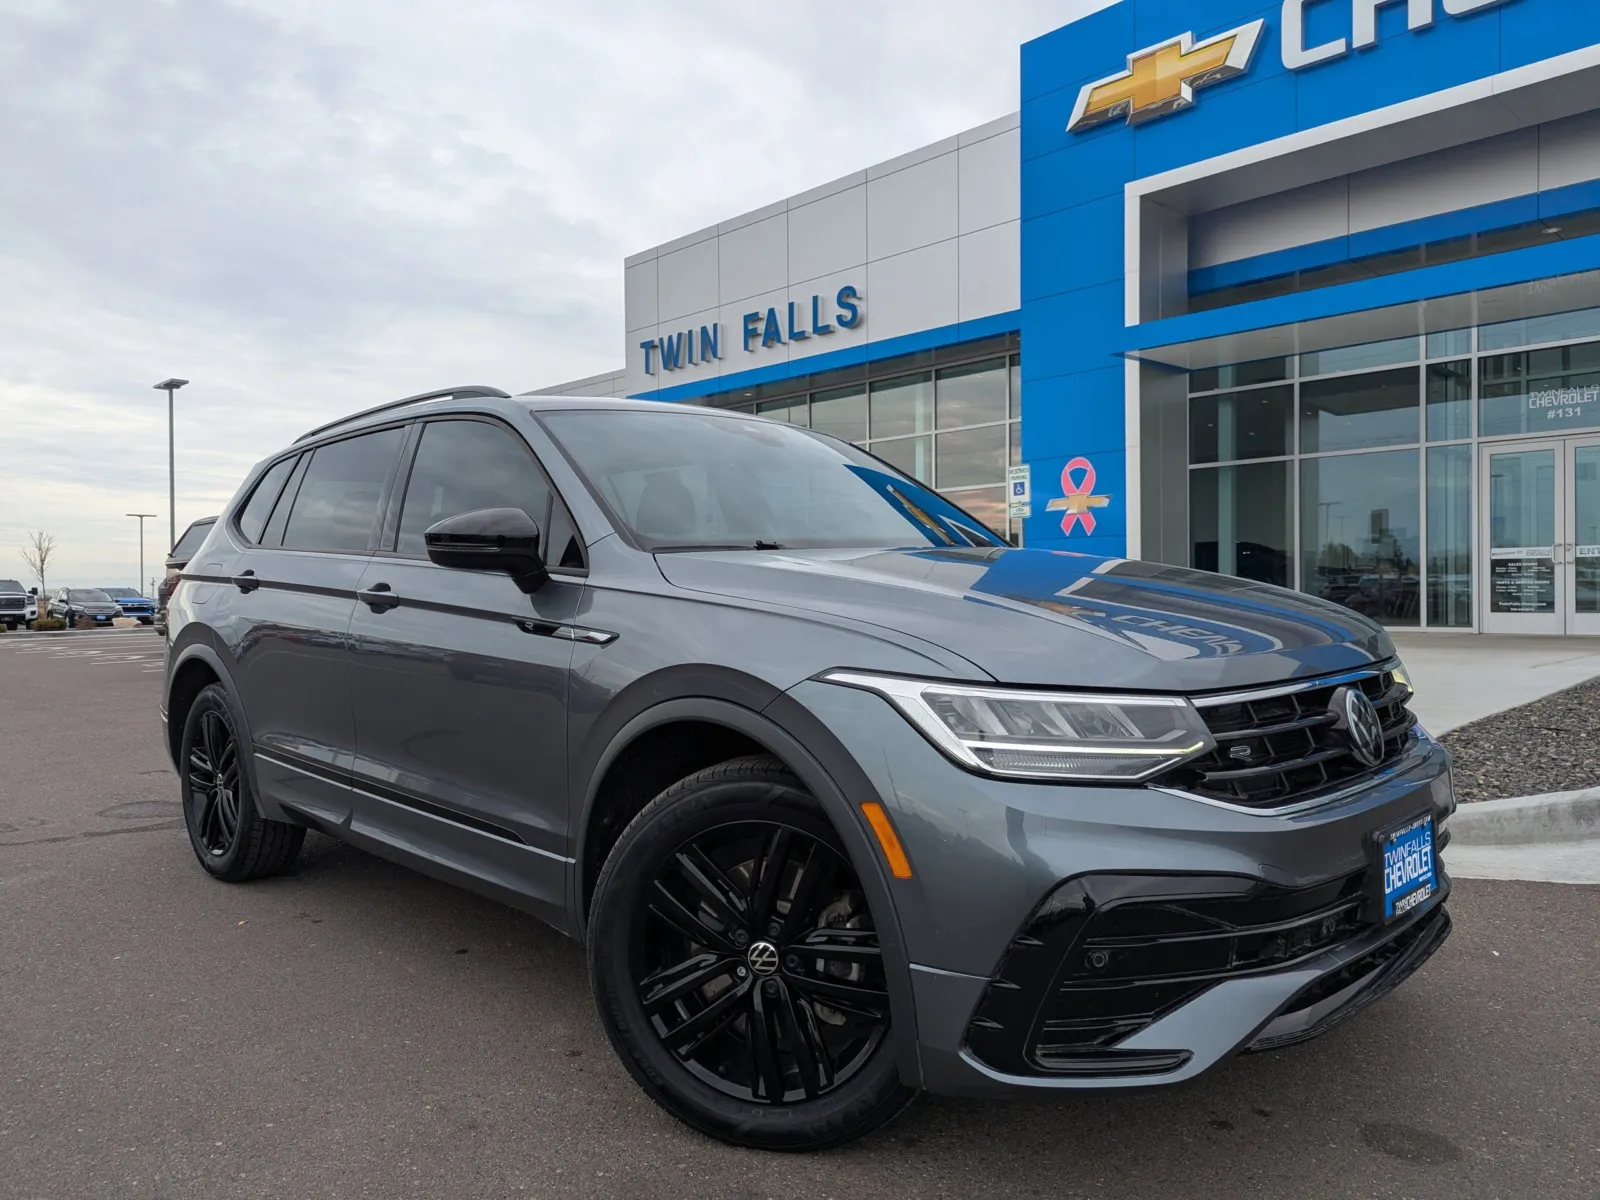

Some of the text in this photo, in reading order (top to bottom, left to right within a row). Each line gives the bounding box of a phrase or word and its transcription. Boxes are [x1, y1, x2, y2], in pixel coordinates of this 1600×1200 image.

[640, 285, 862, 375] TWIN FALLS
[1529, 384, 1600, 399] TWINFALLS
[1529, 391, 1599, 409] CHEVROLET
[1547, 406, 1581, 420] #131
[1384, 831, 1431, 868] TWINFALLS
[1384, 845, 1432, 895] CHEVROLET
[1405, 883, 1432, 910] CHEVROLET
